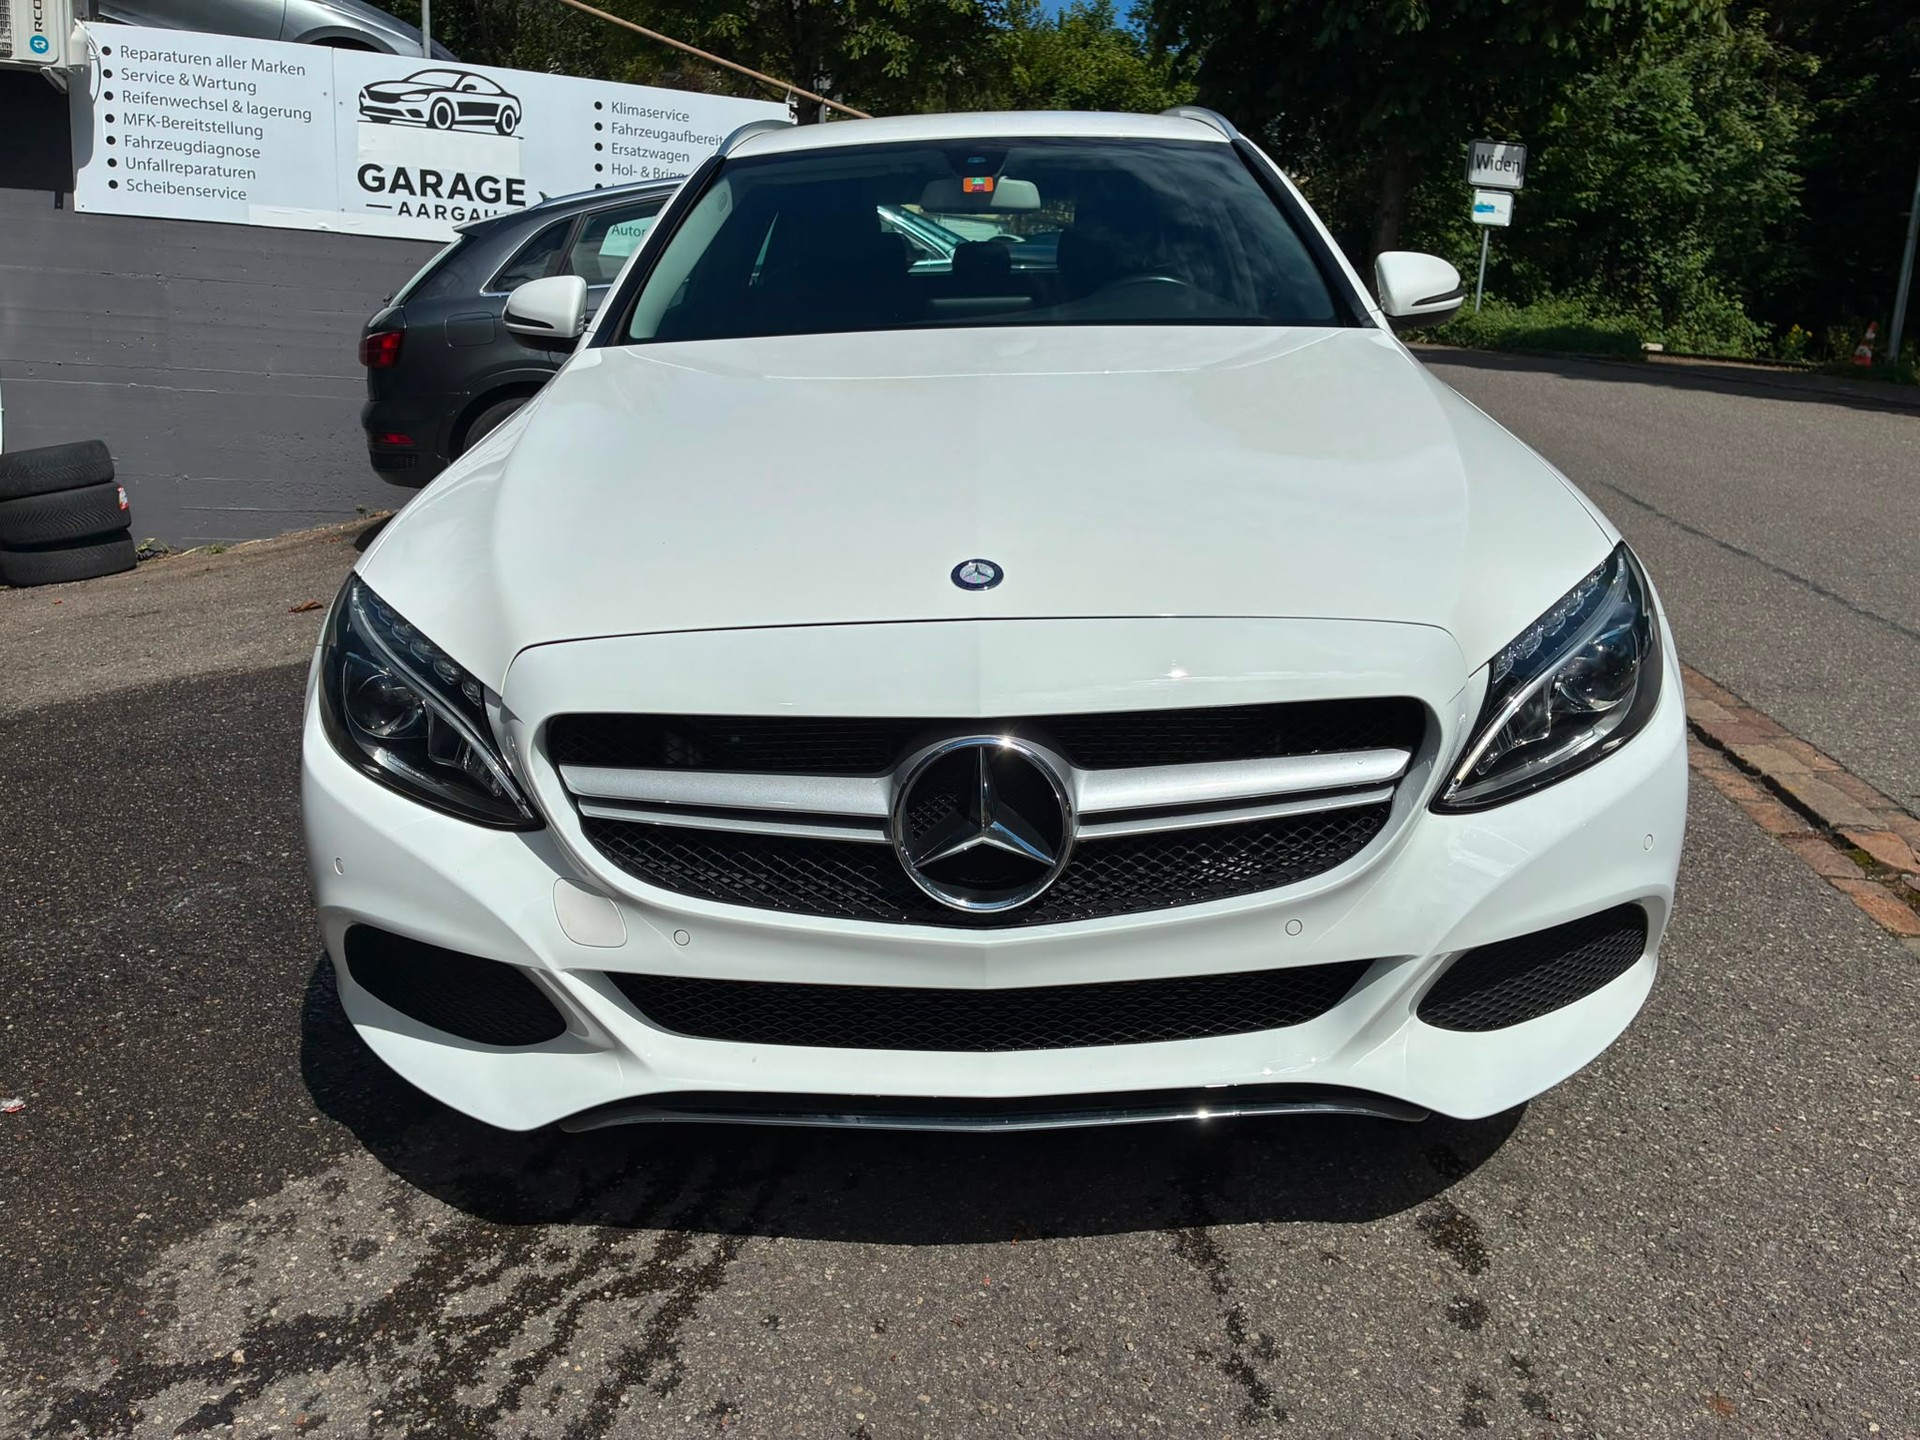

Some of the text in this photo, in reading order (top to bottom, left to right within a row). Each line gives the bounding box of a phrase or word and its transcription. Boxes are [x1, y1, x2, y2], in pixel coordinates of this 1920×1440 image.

[120, 45, 306, 76] Reparaturen aller Marken
[121, 68, 257, 95] Service & Wartung
[122, 90, 312, 123] Reifenwechsel & lagerung
[611, 101, 690, 122] Klimaservice
[123, 113, 264, 140] MFK-Bereitstellung
[124, 135, 261, 159] Fahrzeugdiagnose
[611, 143, 690, 163] Ersatzwagen
[125, 157, 256, 180] Unfallreparaturen
[611, 163, 638, 177] Hol-
[640, 166, 650, 178] &
[1476, 153, 1520, 174] Widen
[126, 178, 247, 200] Scheibenservice
[357, 163, 527, 207] GARAGE
